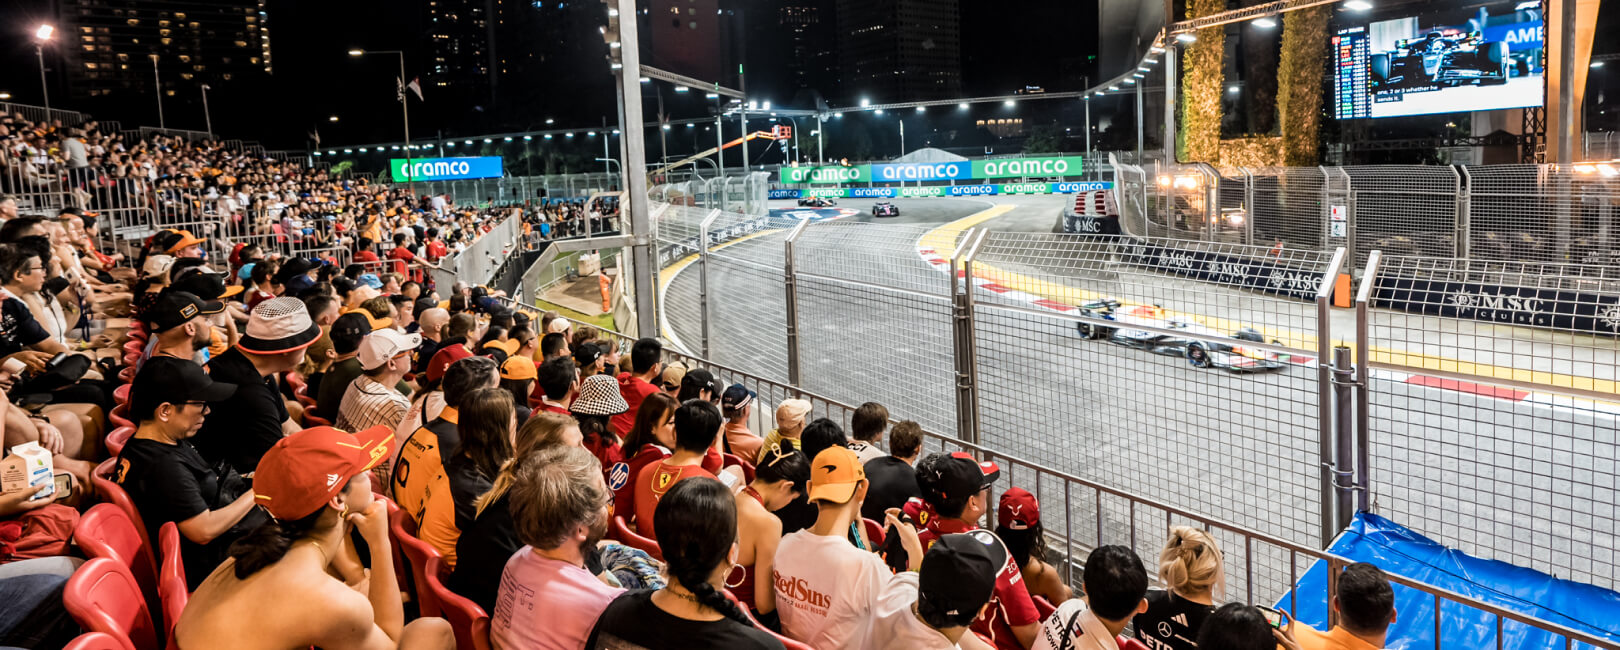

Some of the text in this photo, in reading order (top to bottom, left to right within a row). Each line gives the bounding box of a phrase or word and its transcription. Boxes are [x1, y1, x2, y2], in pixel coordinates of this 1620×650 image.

[401, 161, 470, 177] aramco
[791, 166, 860, 182] aramco
[883, 163, 959, 179] aramco
[984, 159, 1068, 175] aramco
[767, 190, 798, 198] aramco
[809, 188, 845, 197] aramco
[854, 187, 892, 196] aramco
[902, 186, 941, 195] aramco
[952, 184, 992, 194] aramco
[1004, 183, 1046, 192] aramco
[1059, 182, 1104, 191] aramco
[1081, 219, 1101, 233] MSC
[1169, 253, 1193, 268] MSC
[1221, 263, 1250, 279] MSC
[1287, 272, 1322, 293] MSC
[1481, 292, 1544, 315] MSC
[610, 463, 628, 490] hp
